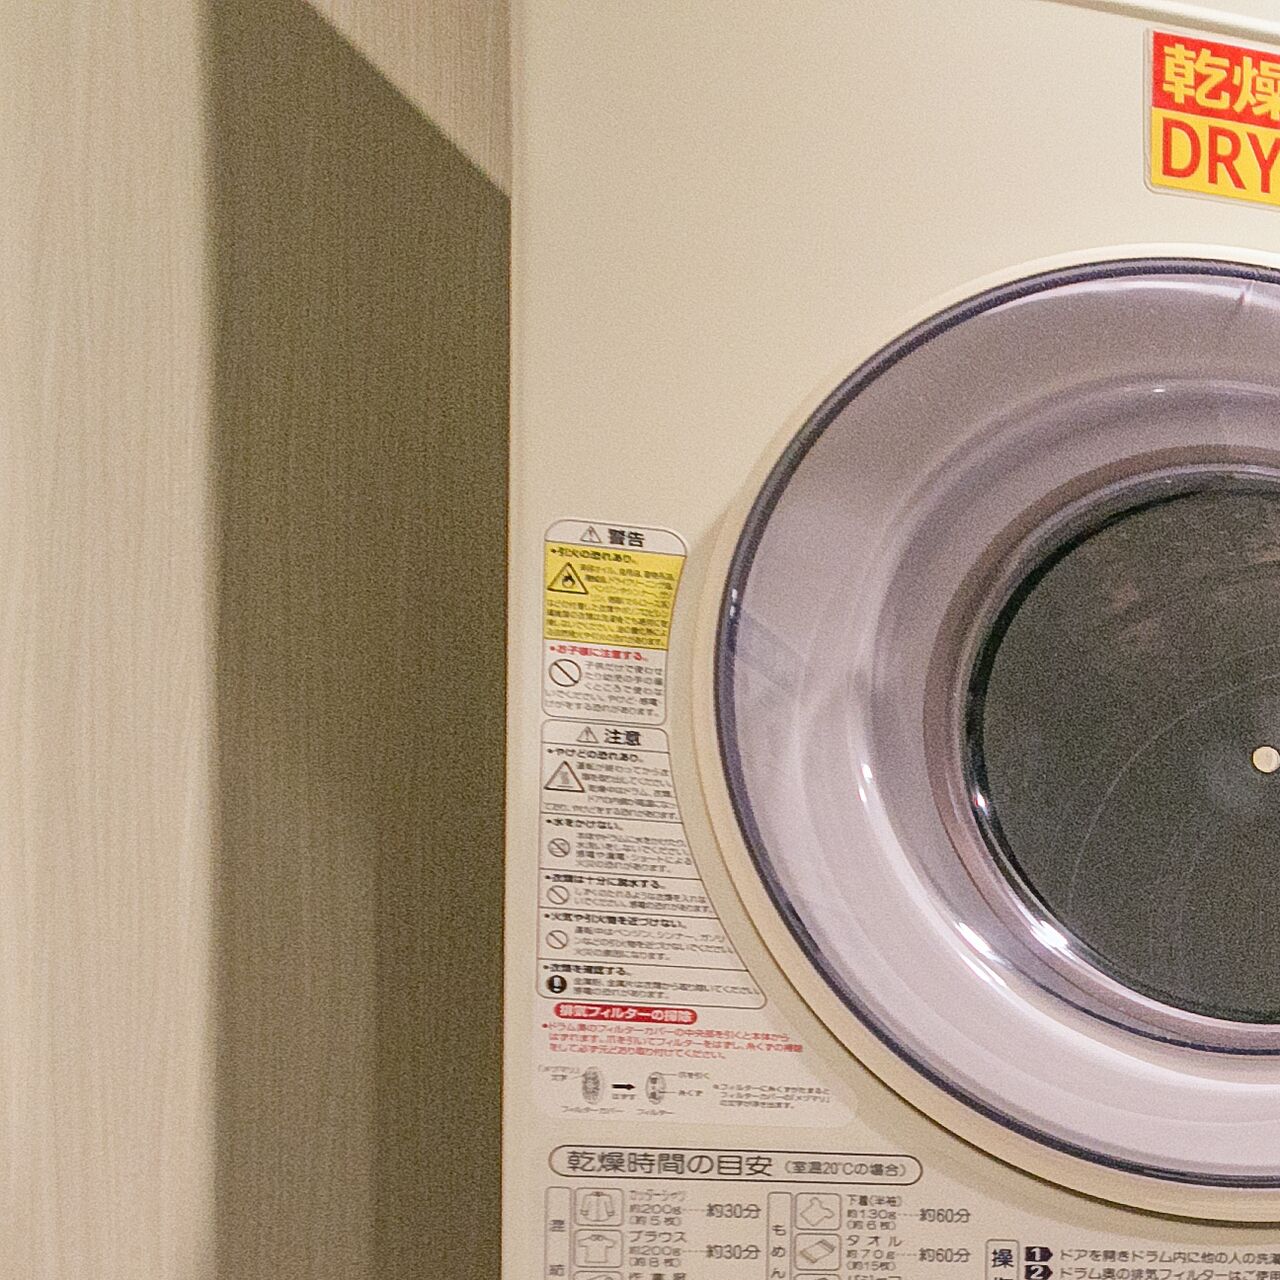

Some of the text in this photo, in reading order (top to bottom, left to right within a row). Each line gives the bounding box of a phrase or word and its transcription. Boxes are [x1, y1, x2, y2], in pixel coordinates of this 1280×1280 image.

[608, 528, 645, 547] 警告
[604, 729, 642, 746] 注意
[567, 1150, 774, 1178] 乾燥時間の目安
[706, 1203, 762, 1219] 約30分
[919, 1208, 971, 1223] 約60分
[706, 1244, 761, 1260] 約30分
[919, 1247, 971, 1263] 約60分
